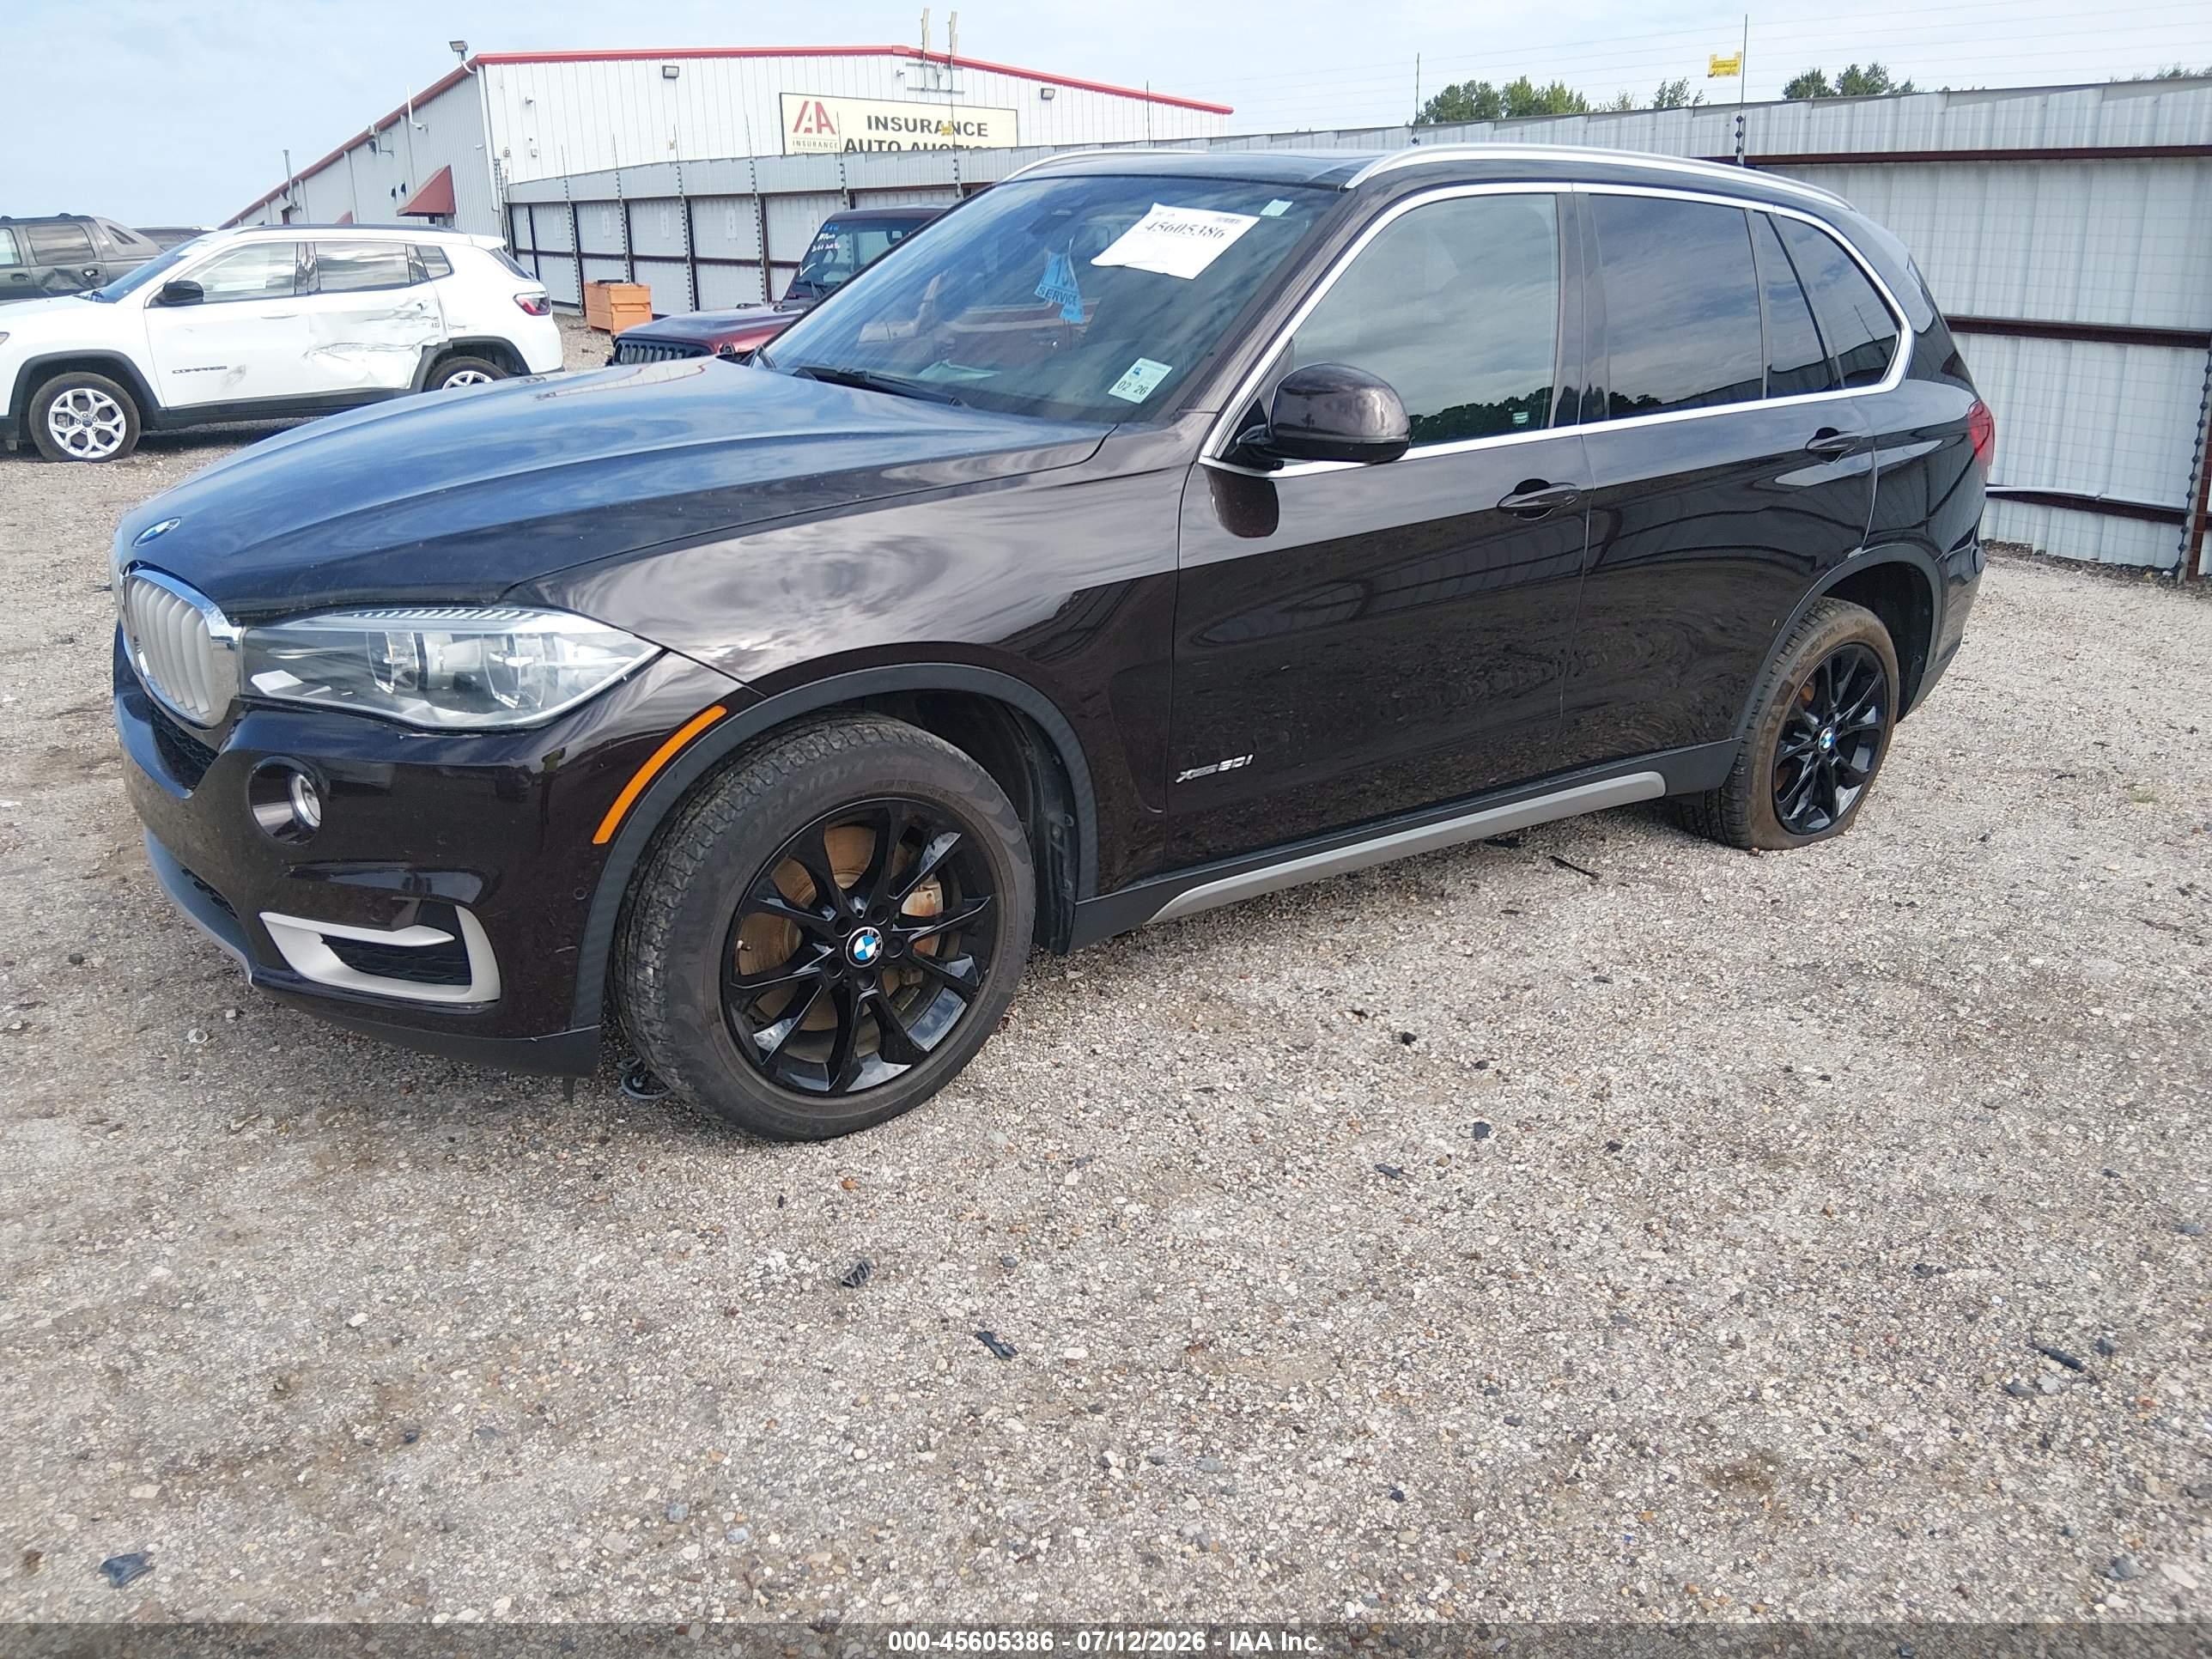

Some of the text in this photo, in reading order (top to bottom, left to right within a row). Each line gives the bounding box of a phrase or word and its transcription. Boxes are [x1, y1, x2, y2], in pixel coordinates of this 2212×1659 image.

[866, 115, 988, 137] INSURANCE
[793, 139, 838, 149] INSURANCE
[844, 138, 902, 152] AUTO
[1145, 221, 1228, 240] 45605386
[1036, 285, 1079, 307] SERVICE
